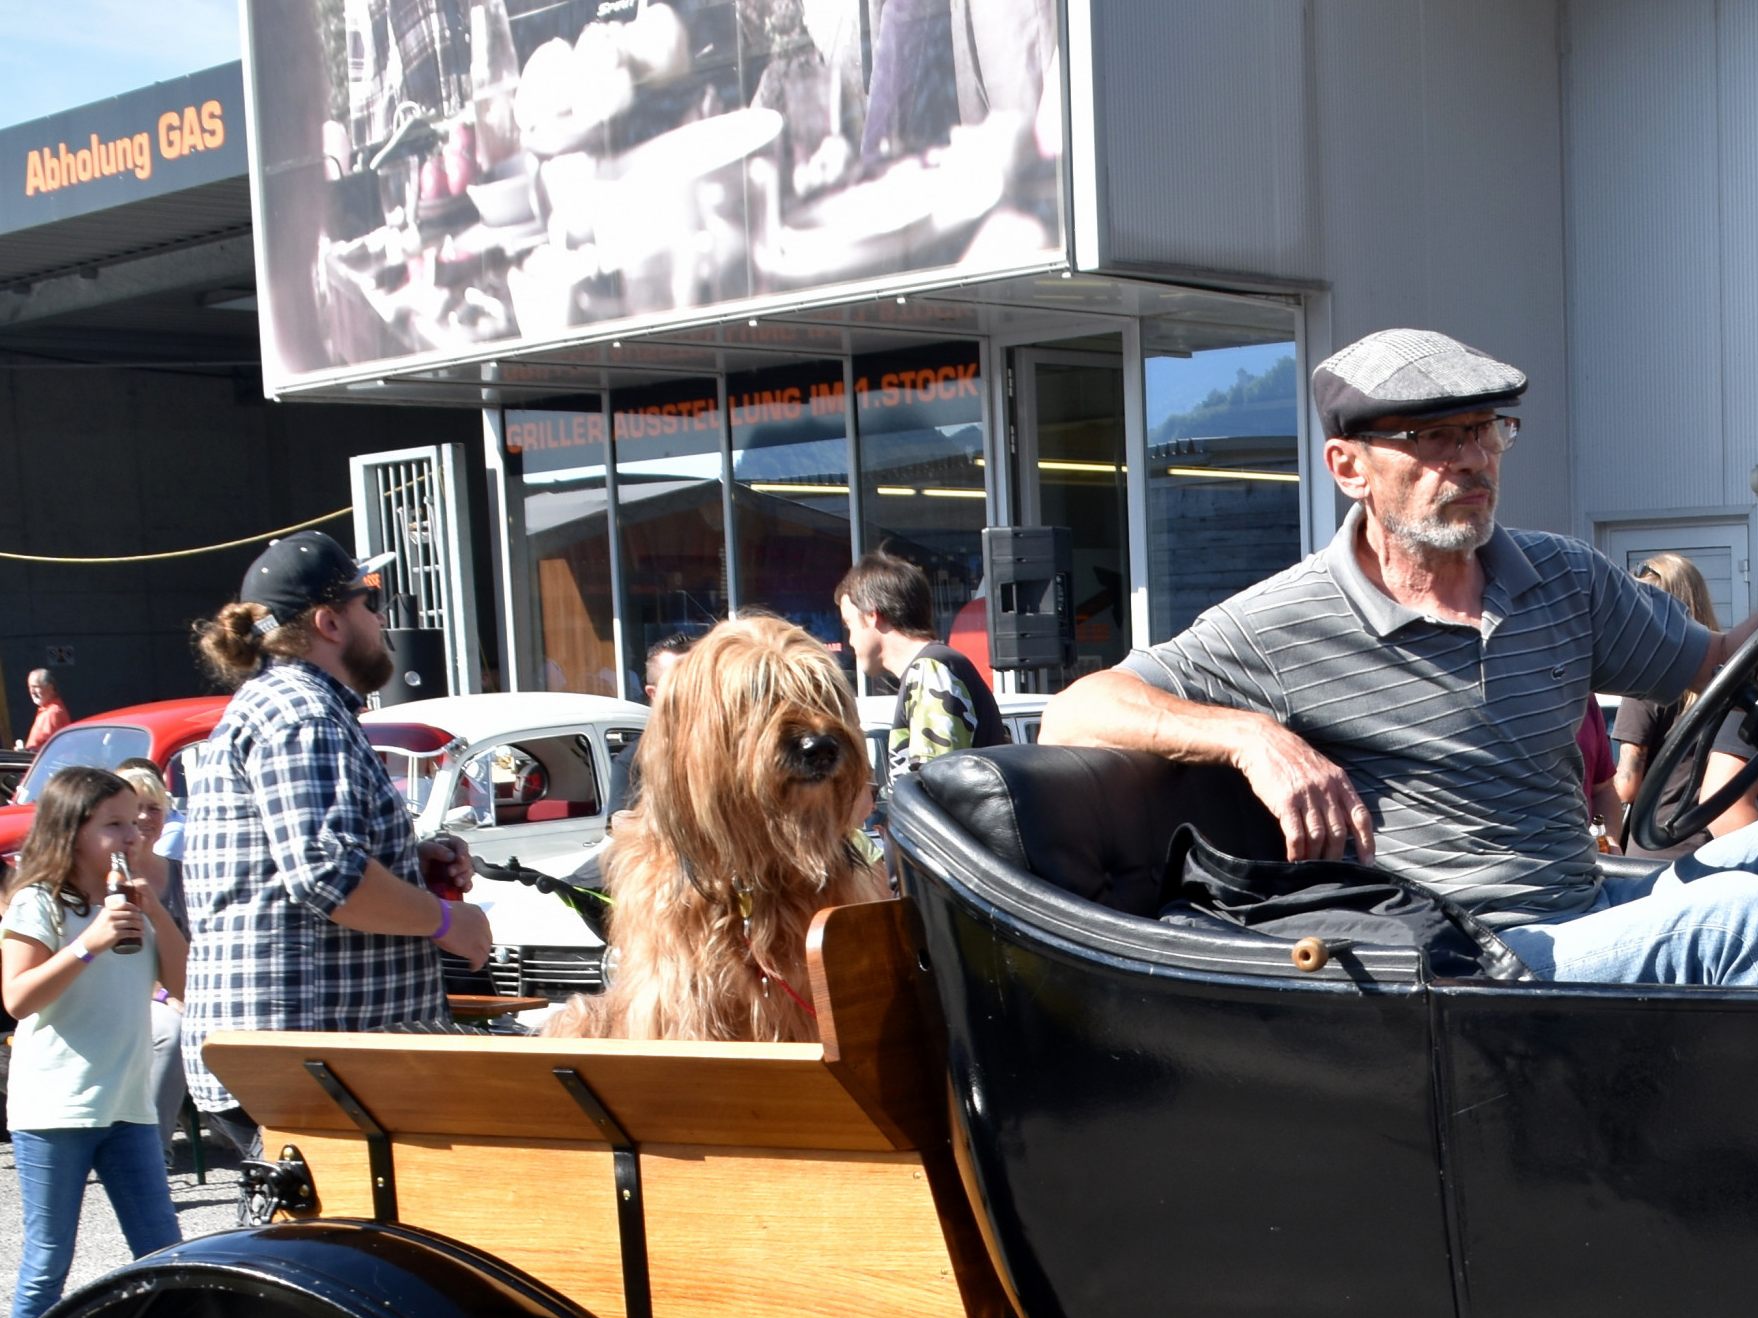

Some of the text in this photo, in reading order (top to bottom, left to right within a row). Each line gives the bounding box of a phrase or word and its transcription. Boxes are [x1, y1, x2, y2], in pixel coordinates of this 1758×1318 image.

[25, 99, 225, 198] Abholung GAS
[505, 414, 604, 455] GRILLER
[810, 381, 847, 418] IM
